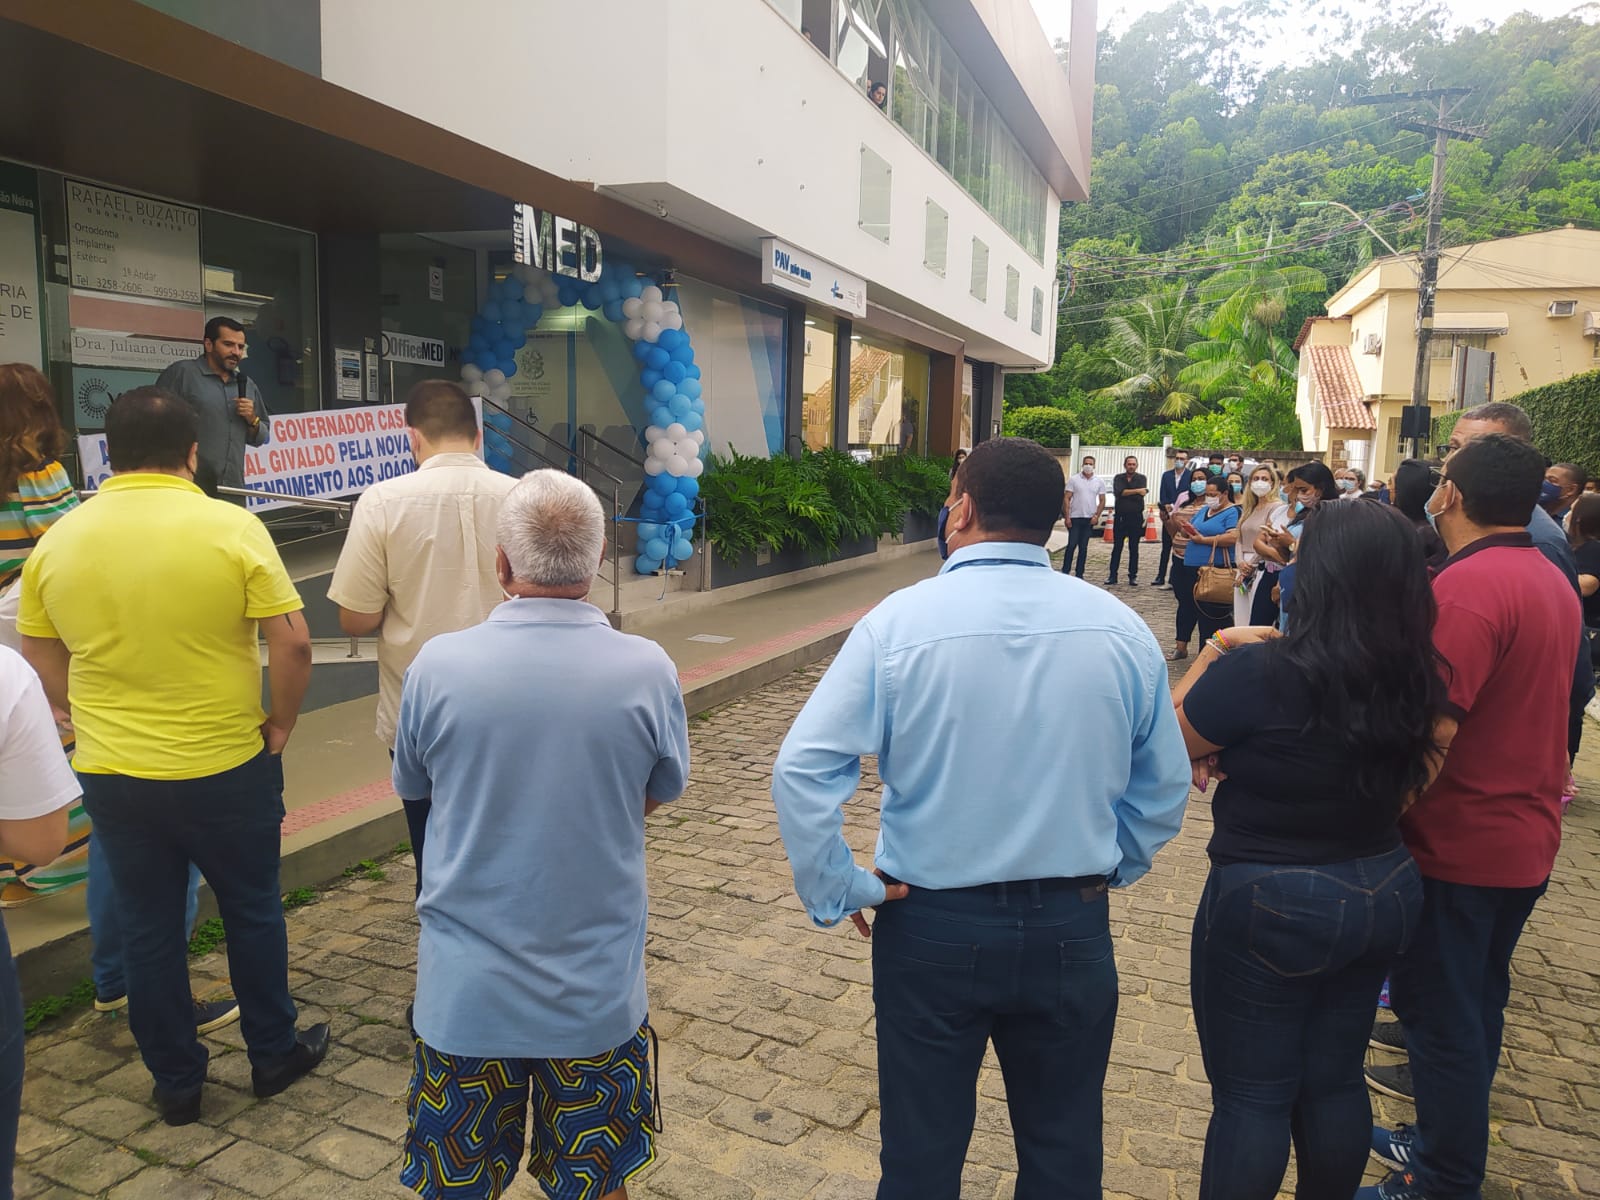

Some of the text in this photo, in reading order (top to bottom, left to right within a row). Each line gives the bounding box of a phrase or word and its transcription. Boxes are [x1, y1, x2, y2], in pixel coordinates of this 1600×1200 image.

[72, 186, 197, 227] RAFAEL BUZATTO
[513, 214, 524, 263] OFFICE
[522, 203, 603, 284] MED
[775, 249, 790, 272] PAV
[134, 269, 157, 282] Andar
[11, 304, 34, 320] DE
[73, 335, 106, 352] Dra.
[110, 339, 157, 354] Juliana
[389, 336, 443, 362] OfficeMED
[274, 411, 374, 443] GOVERNADOR
[378, 408, 407, 432] CAS
[244, 434, 411, 477] AL GIVALDO PELA NOVA
[348, 465, 375, 489] AOS
